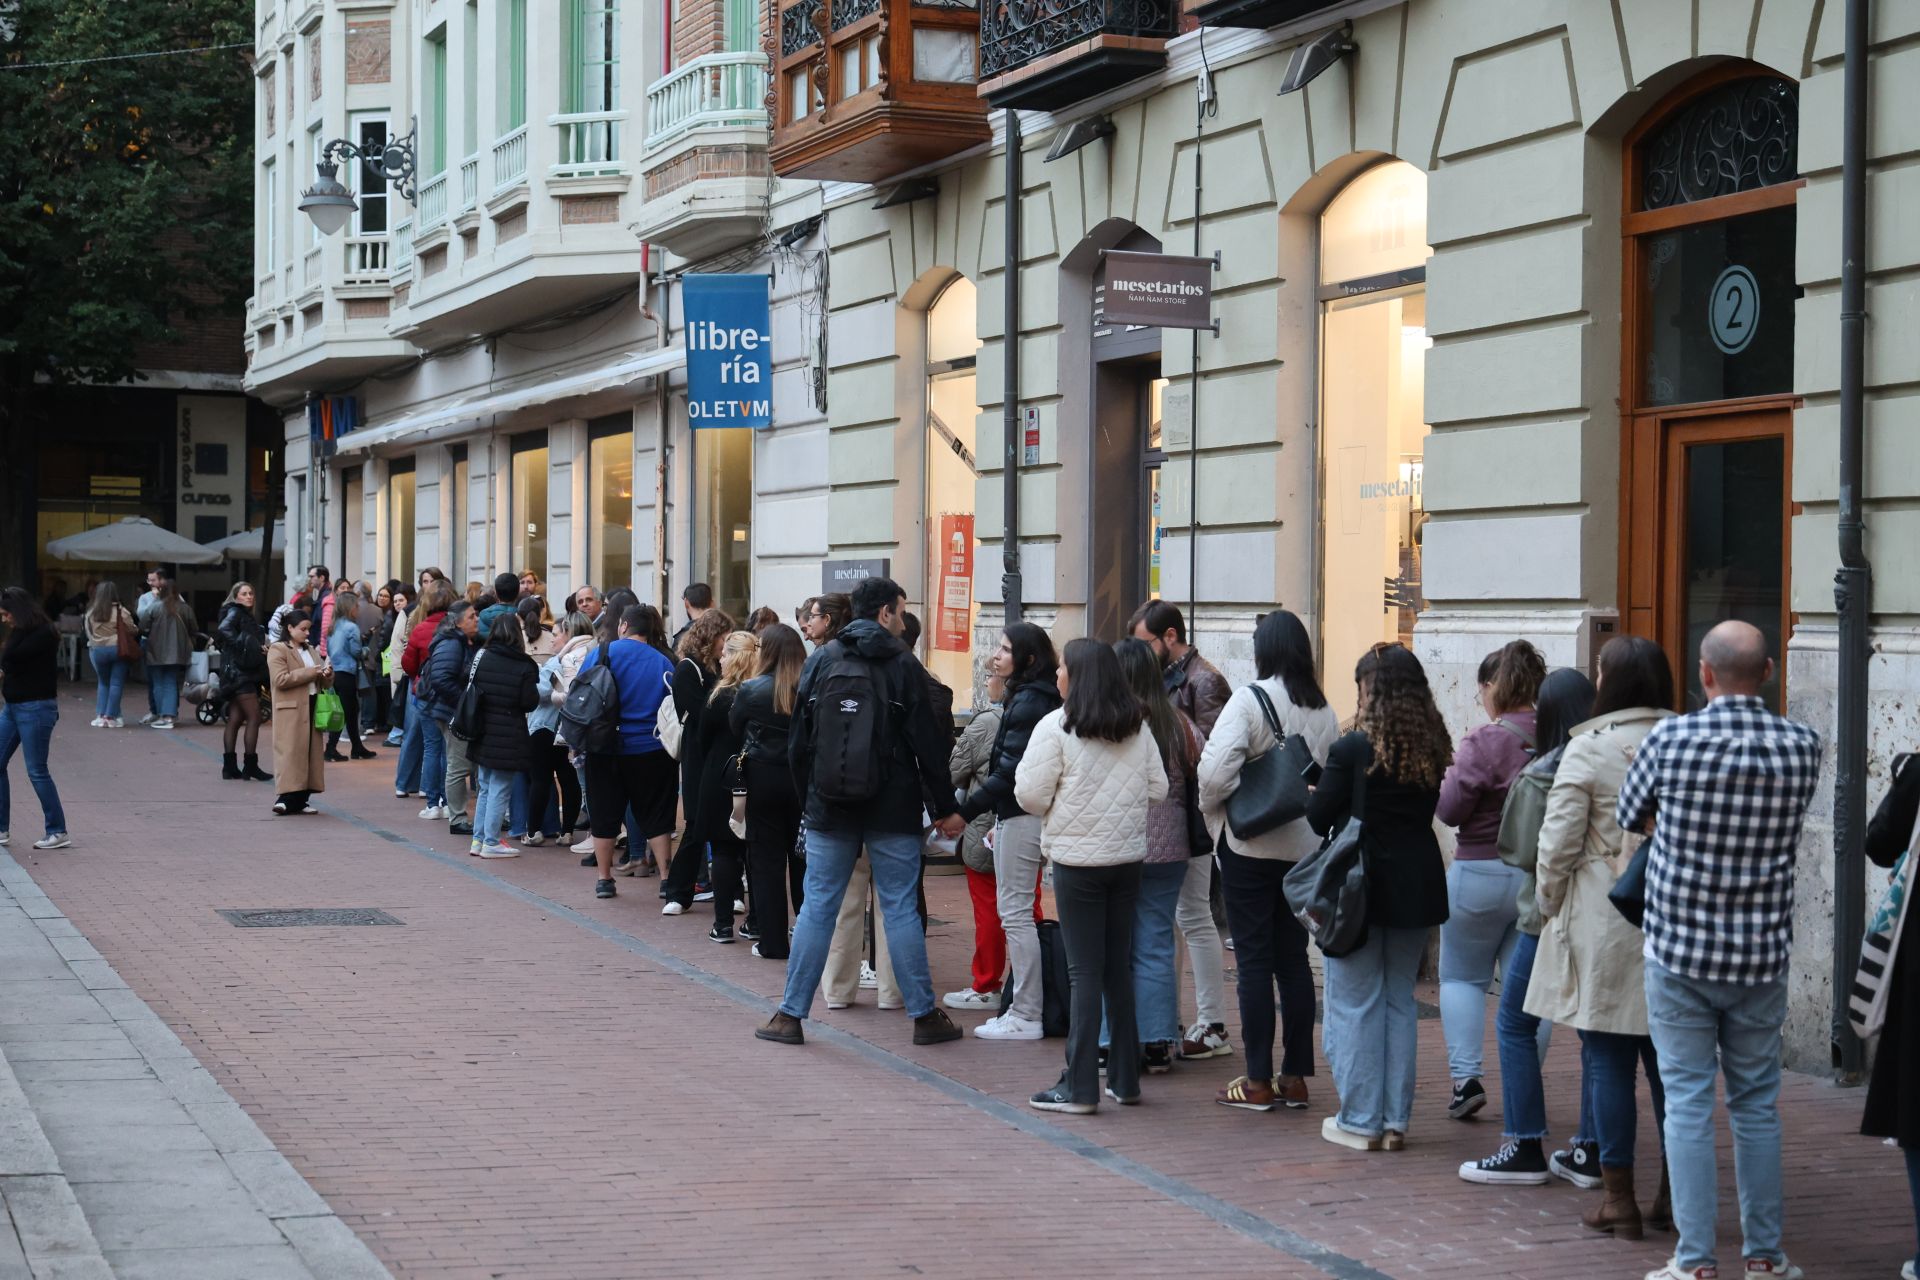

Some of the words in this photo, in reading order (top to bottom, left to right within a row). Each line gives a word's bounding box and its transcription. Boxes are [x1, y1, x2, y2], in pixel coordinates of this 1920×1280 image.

[1113, 280, 1203, 296] mesetarios
[1128, 293, 1145, 302] ÑAM
[1146, 294, 1163, 303] ÑAM
[1164, 297, 1187, 305] STORE
[1726, 285, 1743, 329] 2
[689, 321, 771, 351] libre-
[720, 354, 760, 384] ría
[688, 400, 769, 418] OLETVM
[182, 493, 232, 505] cursos
[834, 565, 870, 580] mesetarios
